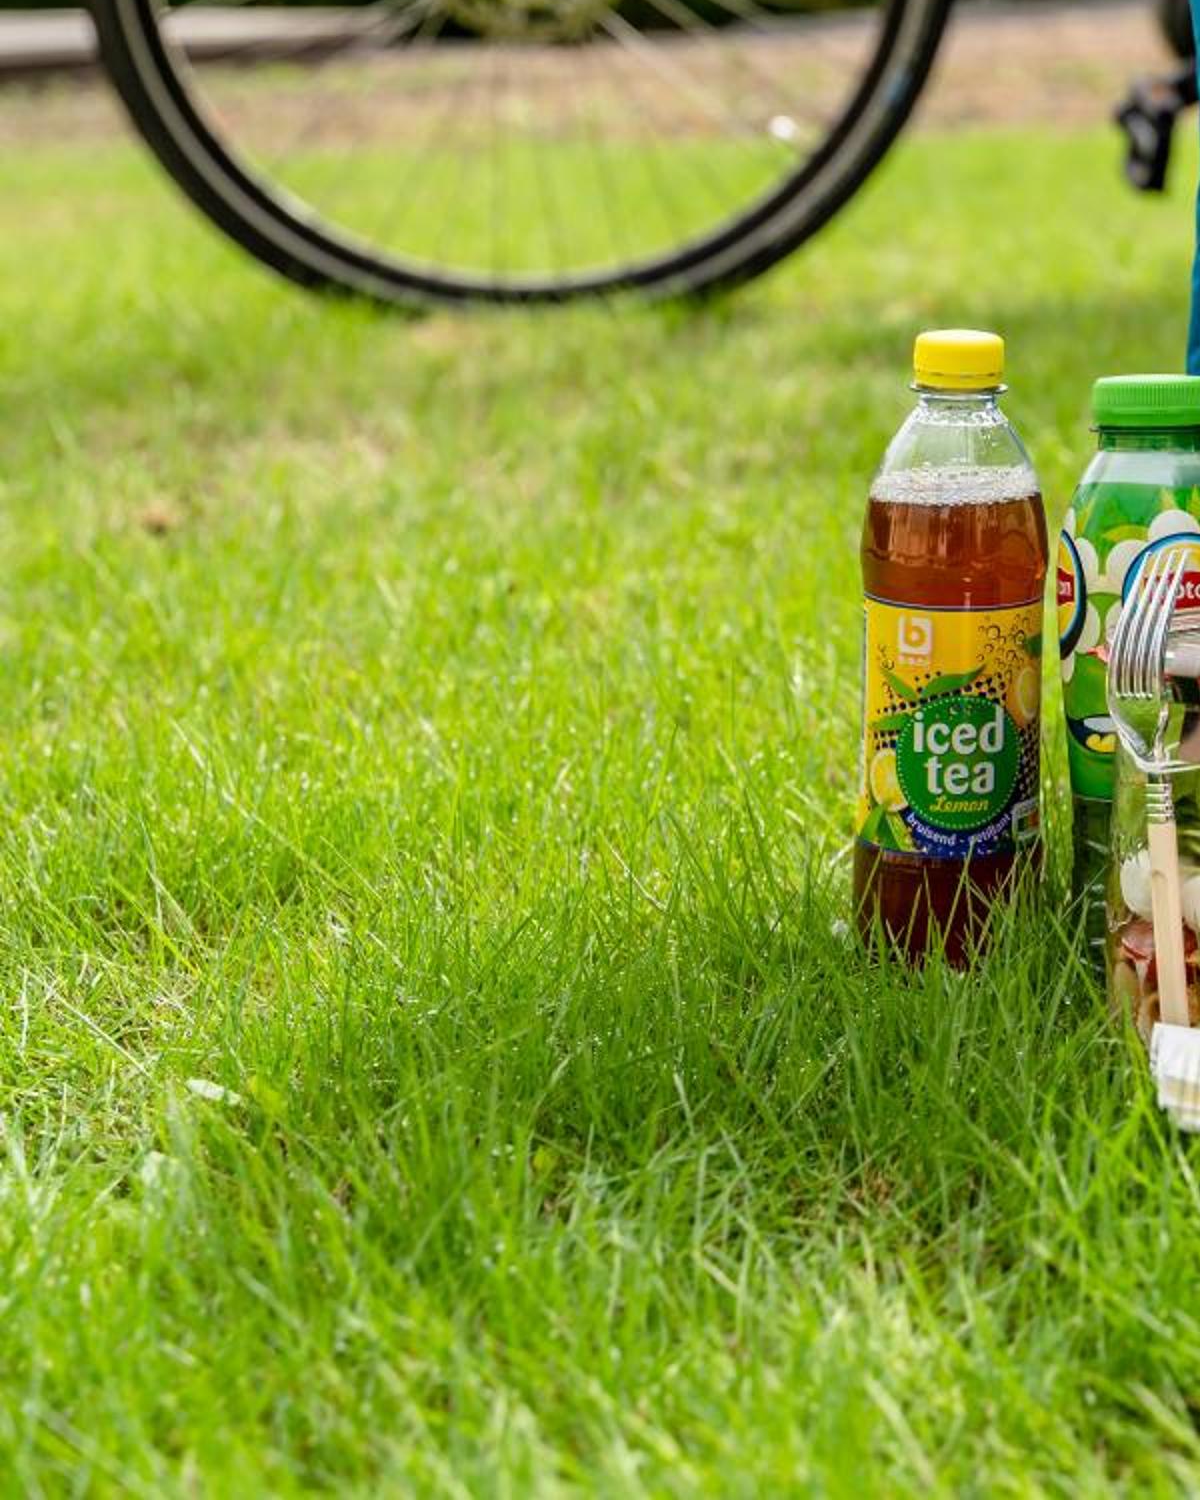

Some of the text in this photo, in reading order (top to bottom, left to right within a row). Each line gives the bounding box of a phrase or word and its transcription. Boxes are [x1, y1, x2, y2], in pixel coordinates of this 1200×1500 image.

[913, 704, 1005, 754] iced
[924, 756, 995, 795] tea
[929, 796, 989, 812] Lemon
[906, 812, 955, 845] bruisend
